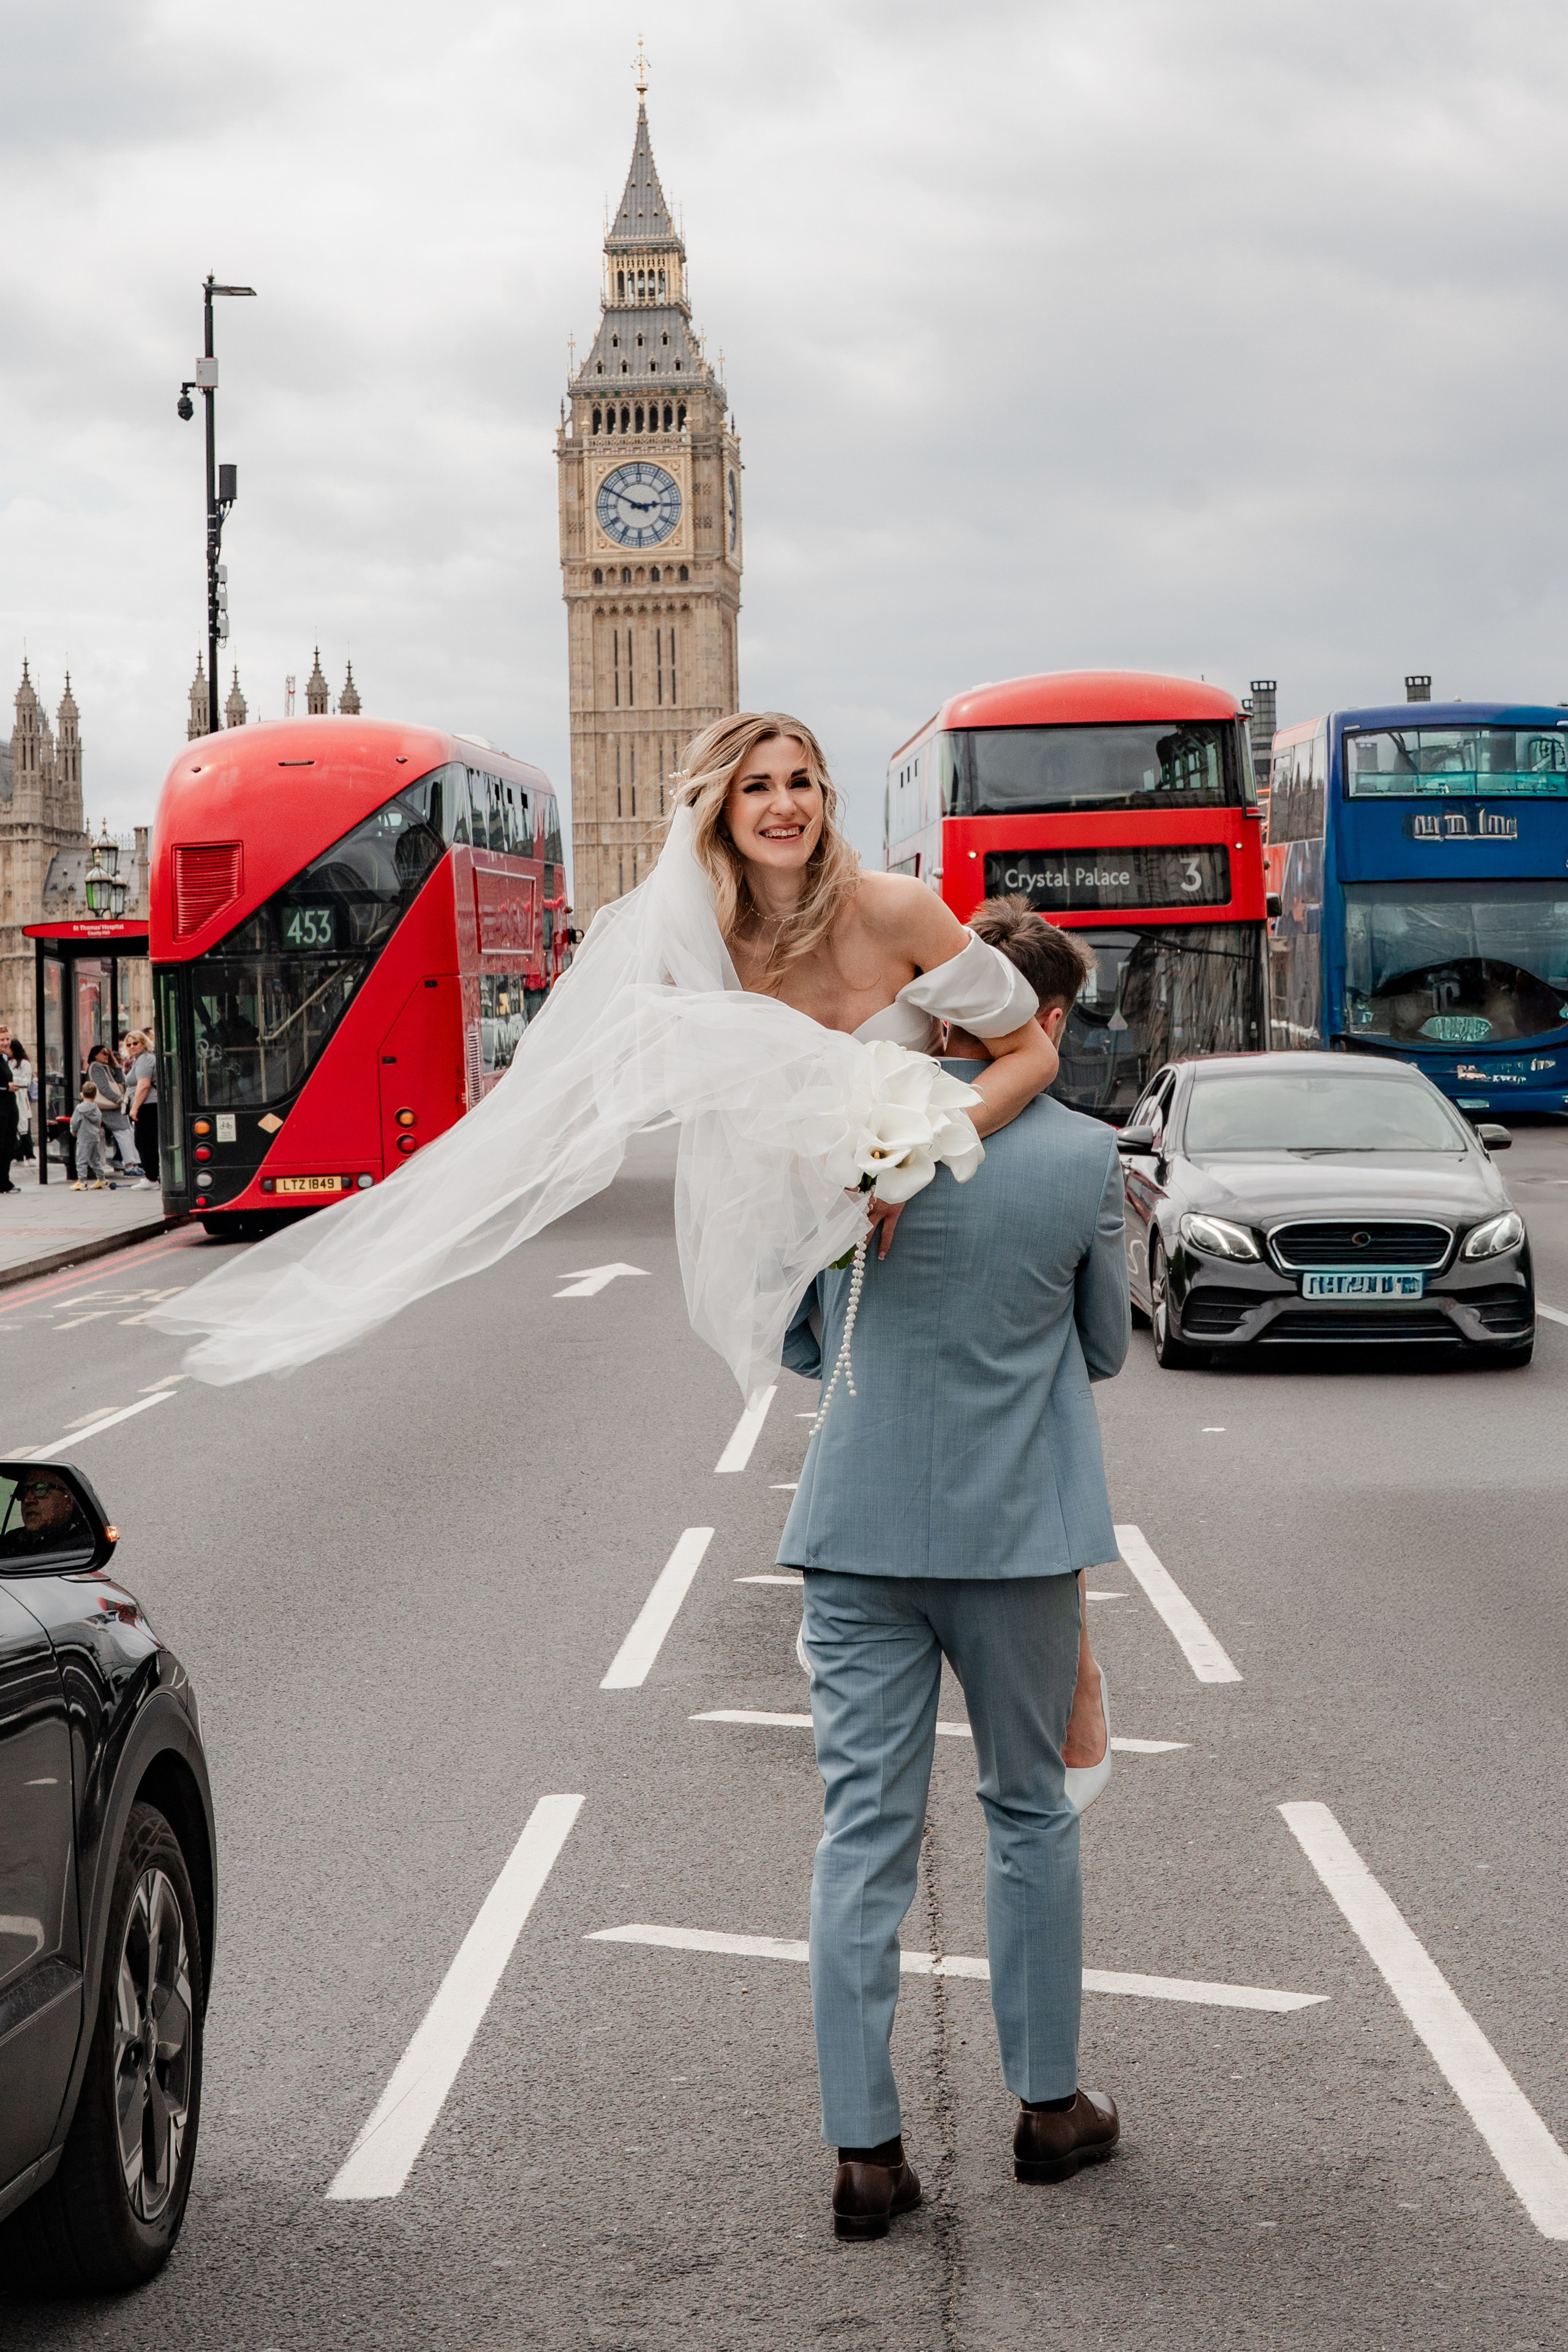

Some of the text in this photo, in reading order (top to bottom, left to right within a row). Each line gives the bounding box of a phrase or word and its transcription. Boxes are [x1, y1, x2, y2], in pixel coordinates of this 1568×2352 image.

[1005, 857, 1202, 893] Crystal Palace 3
[287, 910, 331, 944] 453
[283, 1178, 334, 1191] LTZ 1849
